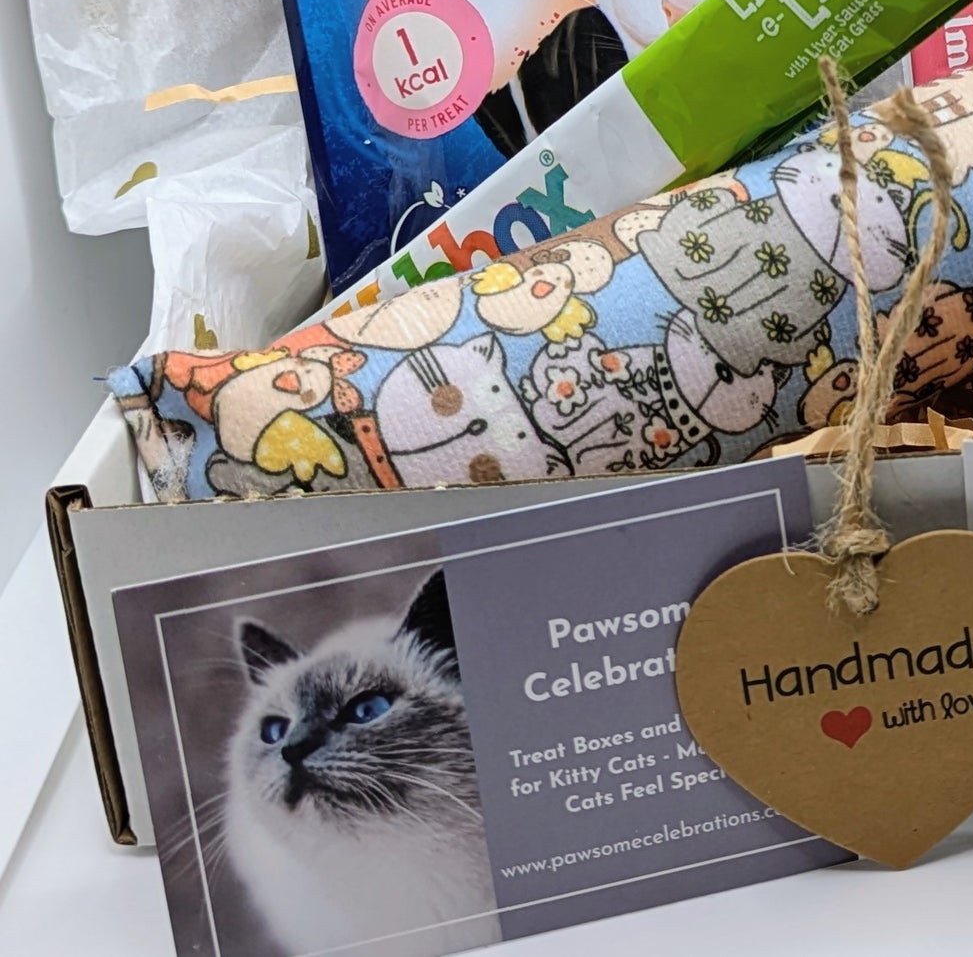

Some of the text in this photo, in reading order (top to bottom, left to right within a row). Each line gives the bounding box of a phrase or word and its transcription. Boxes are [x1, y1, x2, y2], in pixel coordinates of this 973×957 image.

[364, 14, 377, 32] ON
[829, 1, 884, 60] Cat Grass
[396, 28, 419, 66] 1
[785, 55, 809, 79] with
[804, 24, 838, 60] Liver
[394, 58, 449, 99] kcal
[408, 95, 469, 133] PER TREAT
[548, 601, 691, 648] Pawsom
[524, 647, 676, 702] Celebrat
[883, 700, 936, 731] with
[509, 714, 682, 768] Treat Boxes and
[510, 778, 542, 797] for
[549, 765, 601, 789] Kitty
[608, 752, 656, 774] Cats
[565, 768, 727, 813] Cats Feel Speci
[500, 807, 782, 879] www.pawsomecelebrations.c
